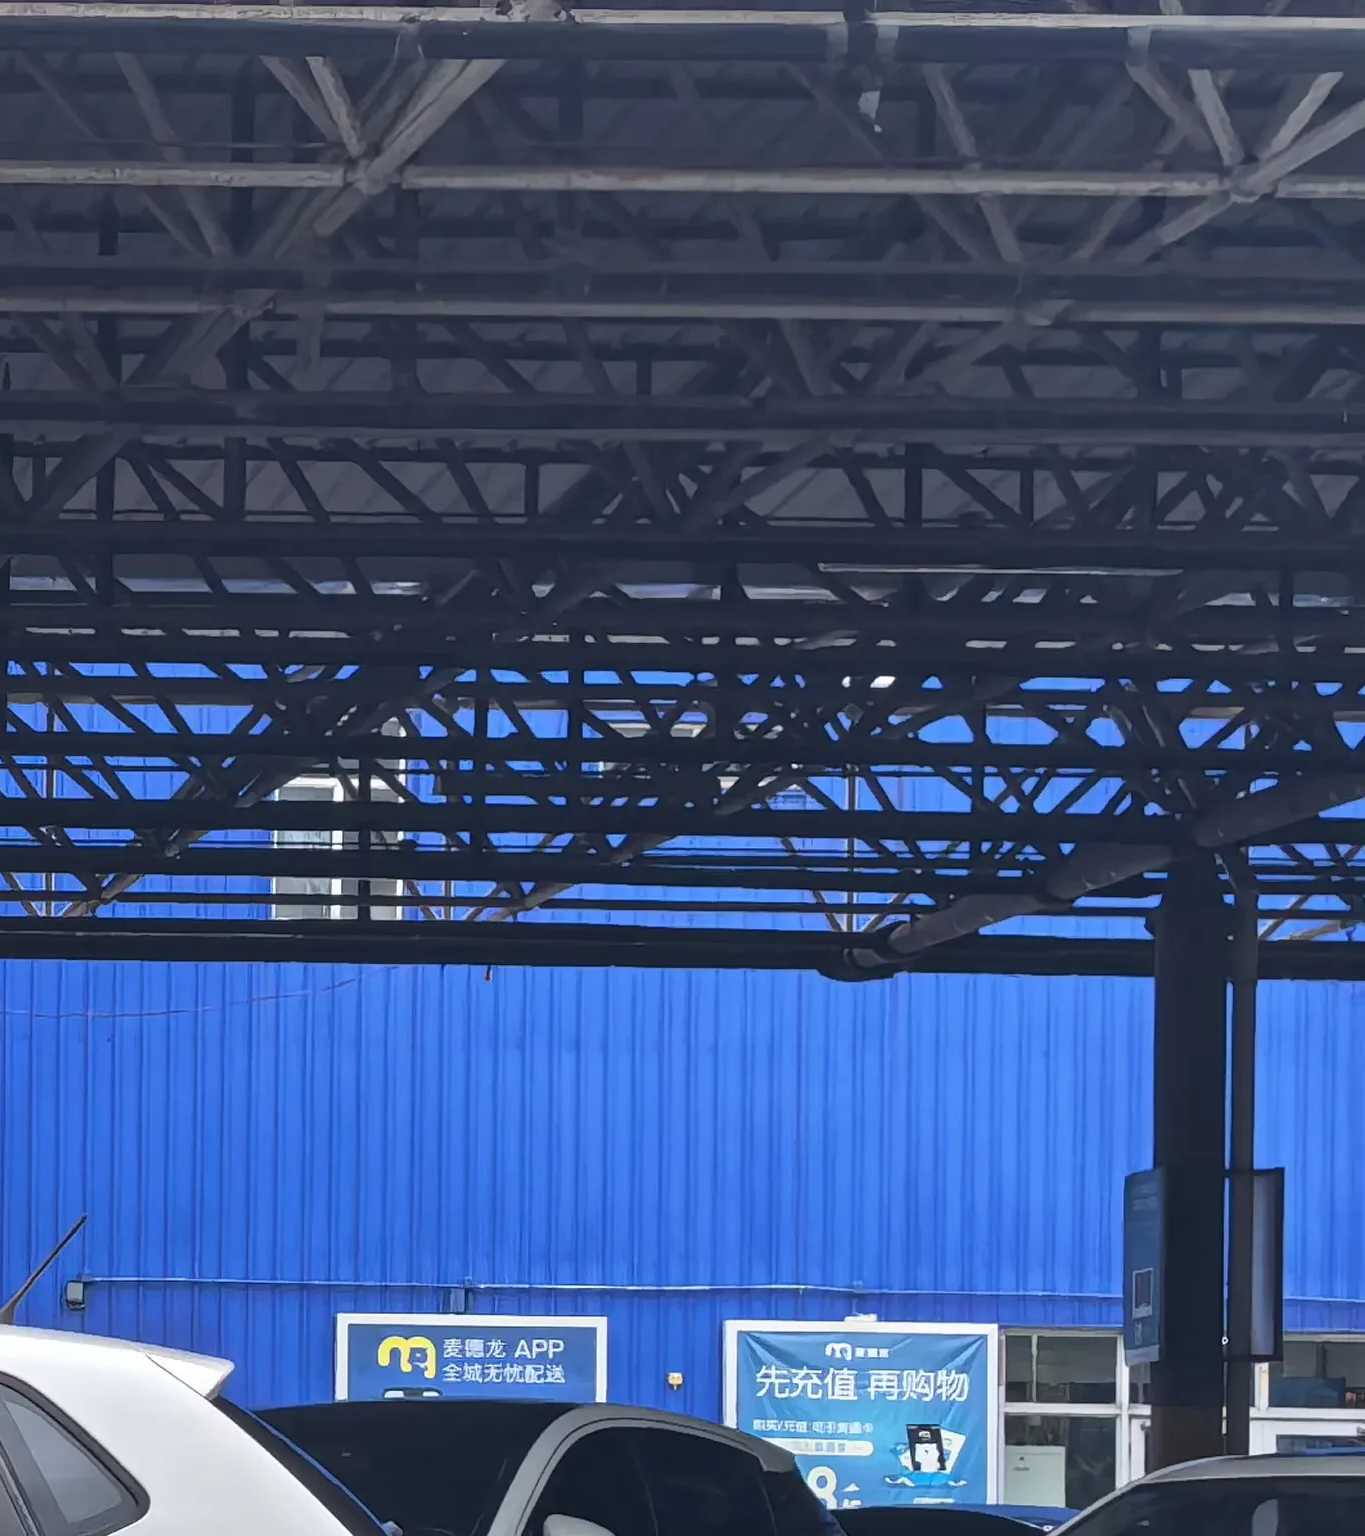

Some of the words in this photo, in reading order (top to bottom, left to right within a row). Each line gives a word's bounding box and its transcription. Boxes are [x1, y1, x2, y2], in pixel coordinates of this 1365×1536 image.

[442, 1338, 507, 1359] 麦德龙
[514, 1339, 566, 1360] APP
[442, 1363, 567, 1384] 全城无忧配送
[755, 1365, 858, 1401] 先充值
[867, 1369, 969, 1402] 再购物
